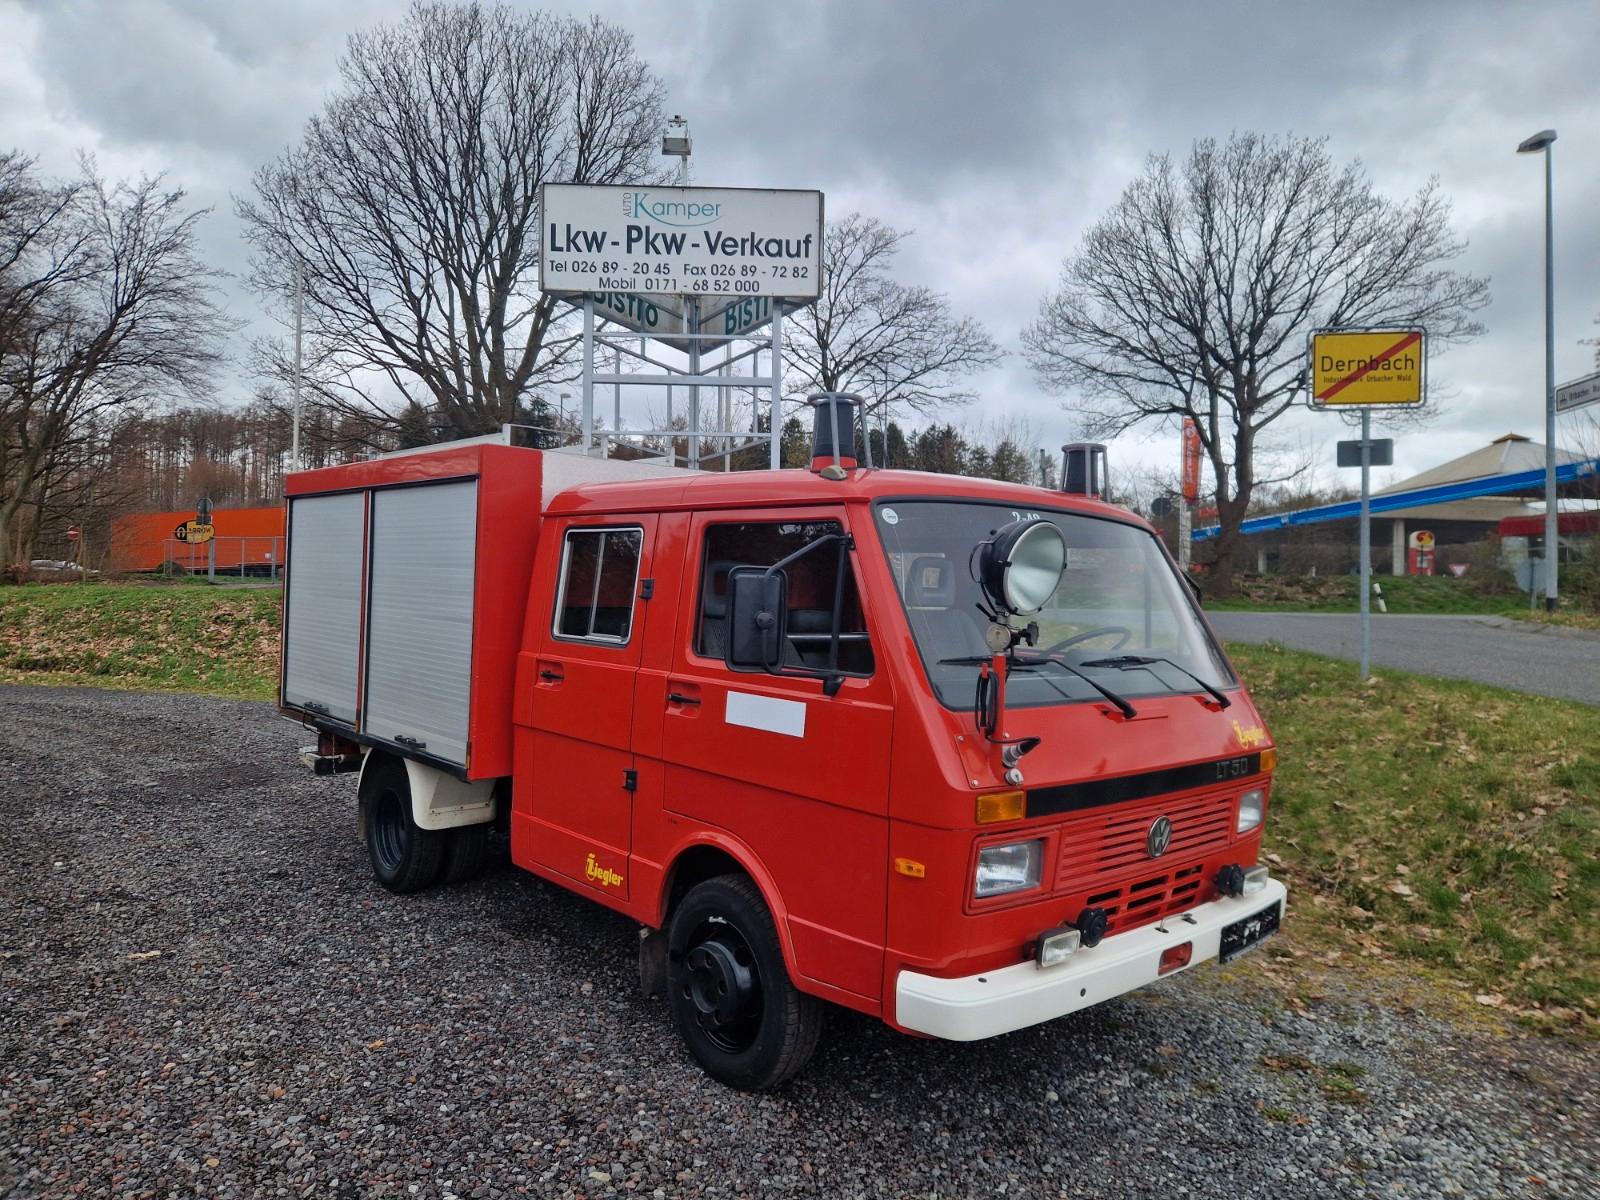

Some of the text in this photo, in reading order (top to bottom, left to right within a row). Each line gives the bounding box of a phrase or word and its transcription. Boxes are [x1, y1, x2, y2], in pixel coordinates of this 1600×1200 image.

[623, 192, 632, 217] AUTO
[634, 193, 721, 221] Kamper
[550, 260, 567, 273] Tel
[571, 260, 597, 273] 026
[602, 261, 619, 274] 89
[633, 262, 650, 275] 20
[654, 263, 671, 275] 45
[683, 264, 706, 276] Fax
[710, 264, 736, 276] 026
[741, 265, 757, 277] 89
[772, 266, 787, 278] 72
[792, 266, 809, 278] 82
[599, 277, 636, 290] Mobil
[645, 279, 677, 291] 0171
[693, 279, 709, 291] 68
[713, 280, 730, 292] 52
[735, 280, 760, 293] 000
[1321, 354, 1414, 372] Dernbach
